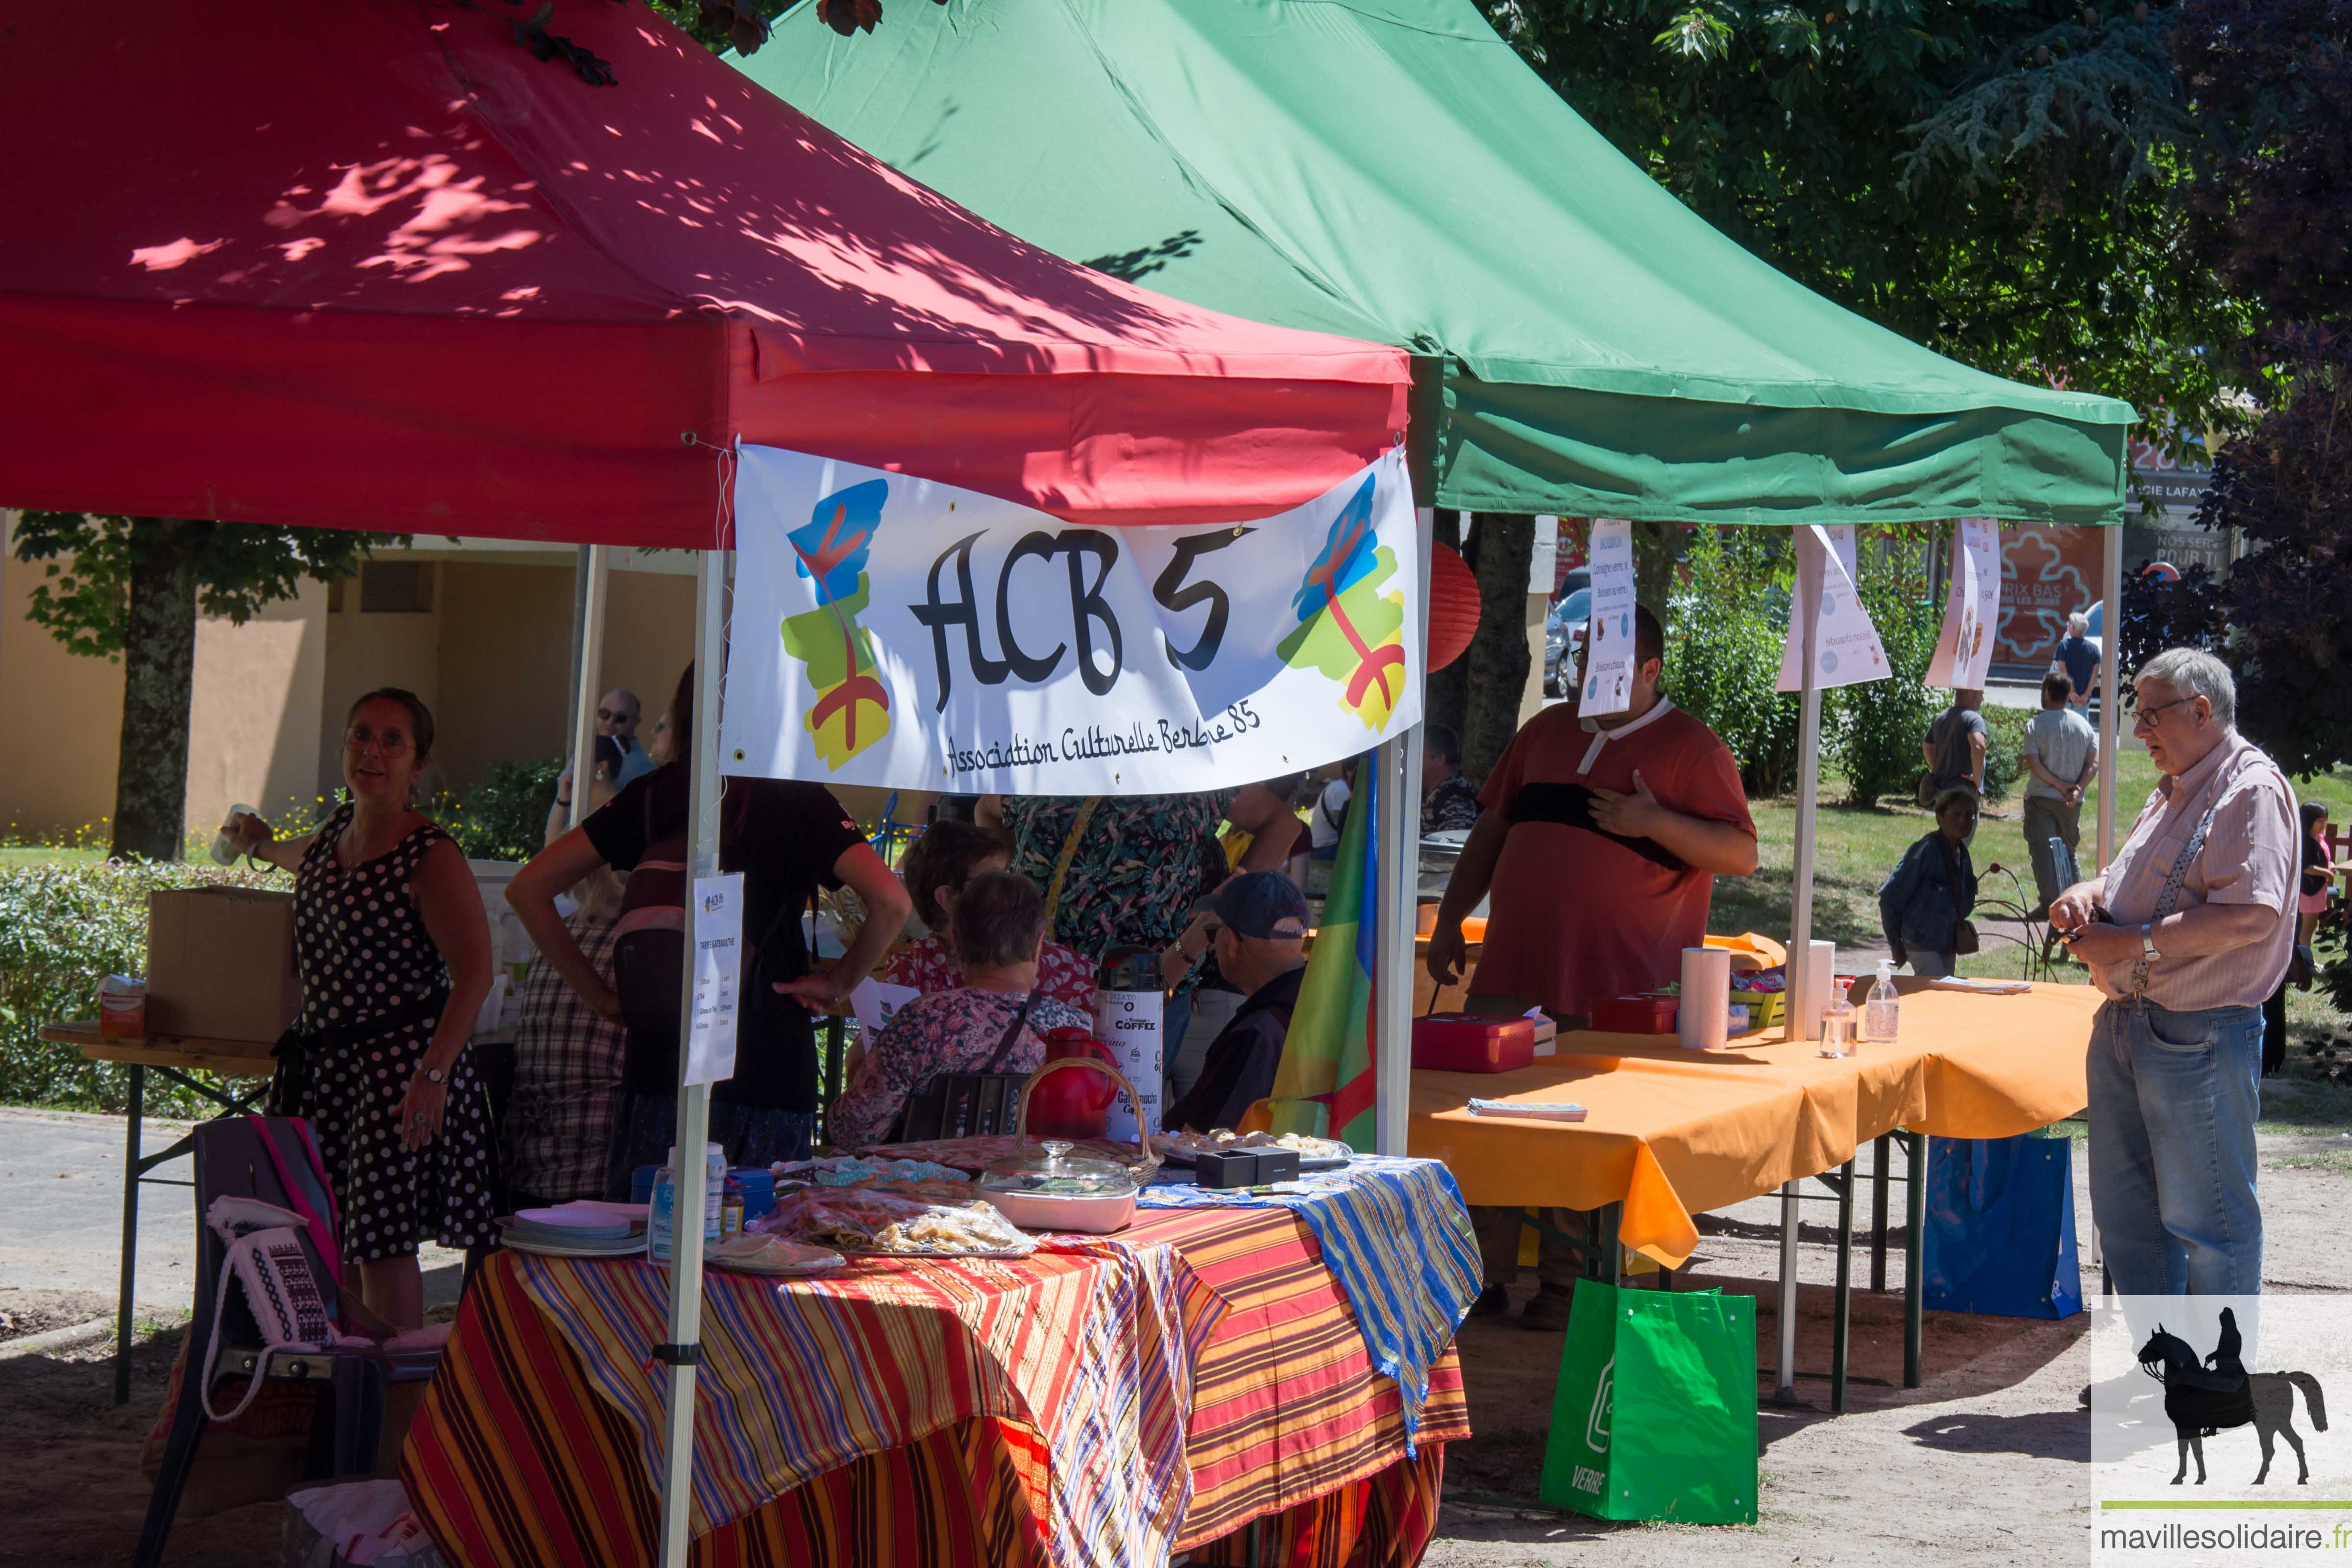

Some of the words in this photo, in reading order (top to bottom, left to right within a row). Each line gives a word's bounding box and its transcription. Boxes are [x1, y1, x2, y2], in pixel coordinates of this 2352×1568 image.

[2157, 535, 2185, 547] NOS
[2157, 548, 2200, 565] POUR
[2033, 583, 2062, 597] BAS
[907, 528, 1123, 715] ACB
[947, 733, 1059, 778] Association
[1062, 721, 1159, 760] Culturelle
[1227, 699, 1260, 733] 85
[1115, 1020, 1155, 1030] COFFEE
[1571, 1465, 1606, 1495] VERRE
